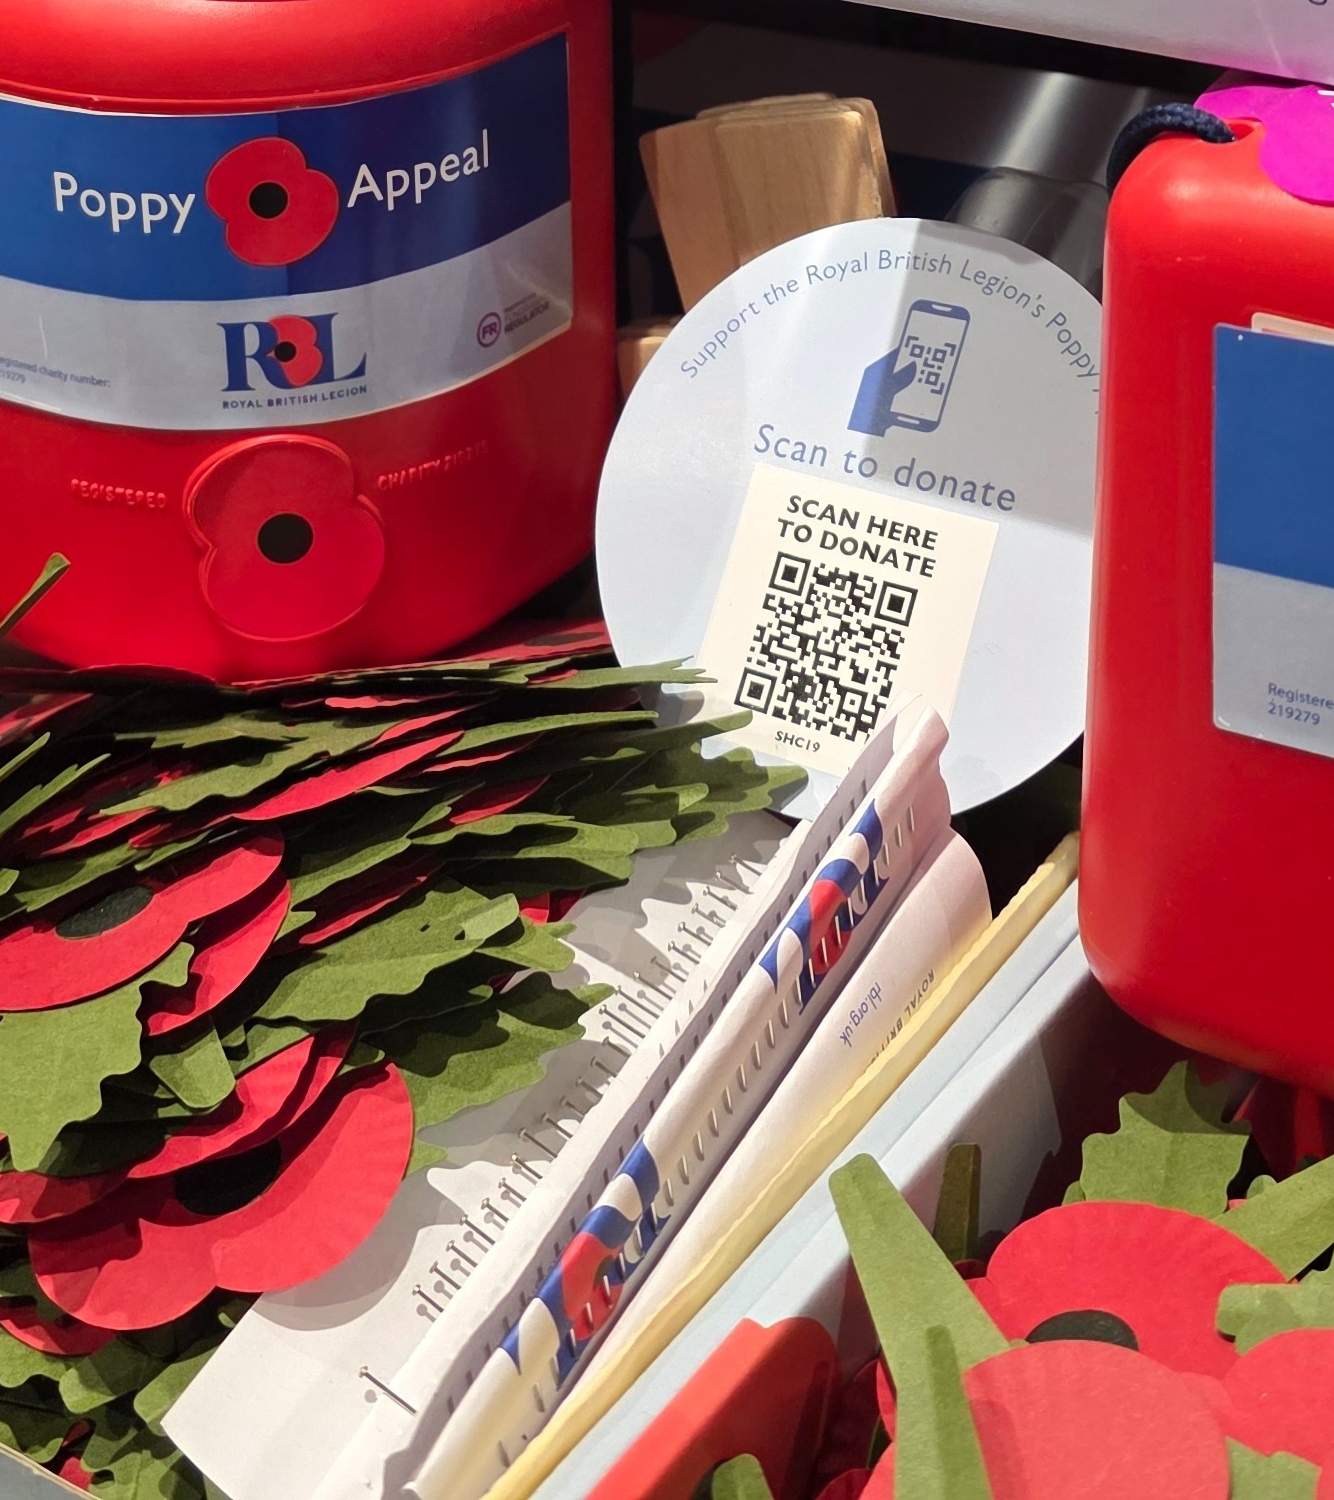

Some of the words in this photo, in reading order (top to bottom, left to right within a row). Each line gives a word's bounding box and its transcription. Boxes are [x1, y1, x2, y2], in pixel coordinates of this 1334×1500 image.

[51, 170, 197, 236] Poppy
[347, 128, 491, 216] Appeal
[680, 300, 761, 379] Support
[762, 278, 800, 306] the
[805, 251, 869, 285] Royal
[877, 249, 953, 276] British
[959, 258, 1046, 319] Legion's
[1045, 311, 1101, 378] Poppy
[38, 365, 68, 383] charity
[69, 373, 112, 388] number:
[222, 397, 264, 410] ROYAL
[265, 392, 319, 409] BRITISH
[321, 384, 368, 403] LEGION
[753, 422, 830, 469] Scan
[841, 448, 880, 480] to
[892, 456, 1018, 513] donate
[776, 517, 815, 548] TO
[818, 527, 938, 580] DONATE
[786, 493, 862, 532] SCAN
[865, 514, 941, 553] HERE
[773, 728, 822, 754] SHC19
[1267, 701, 1321, 726] 219279
[839, 981, 883, 1049] rbl.org.uk
[904, 968, 936, 1018] ROYAL
